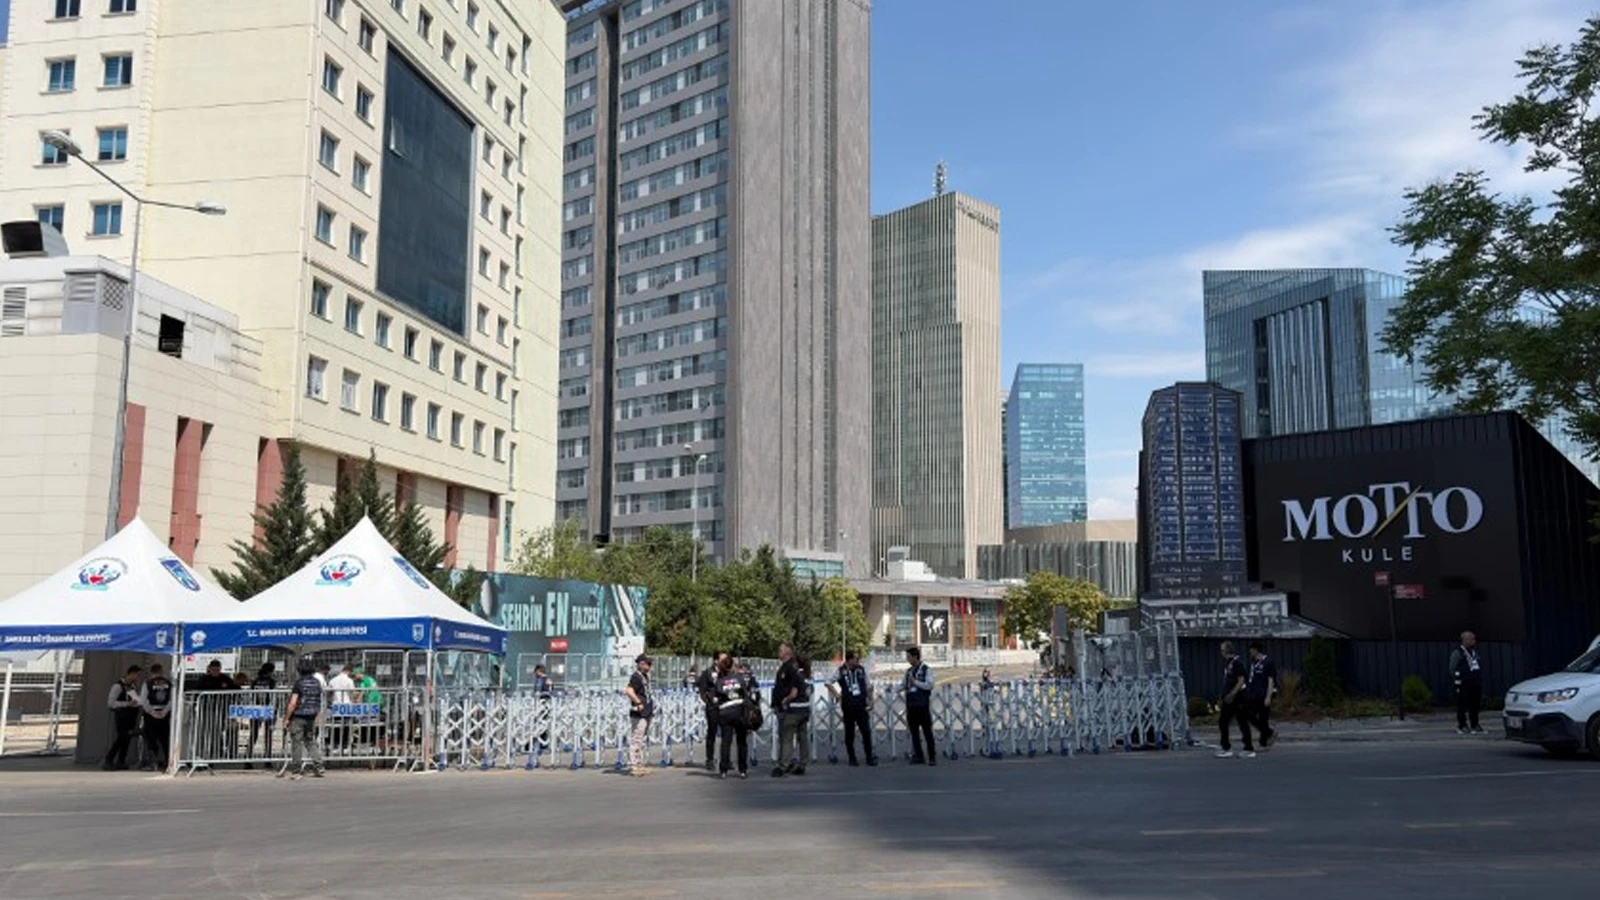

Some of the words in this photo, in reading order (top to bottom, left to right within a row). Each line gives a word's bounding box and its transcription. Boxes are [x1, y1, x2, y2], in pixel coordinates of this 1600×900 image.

[1281, 481, 1484, 542] MOTTO
[1342, 546, 1412, 563] KULE
[545, 592, 570, 637] EN
